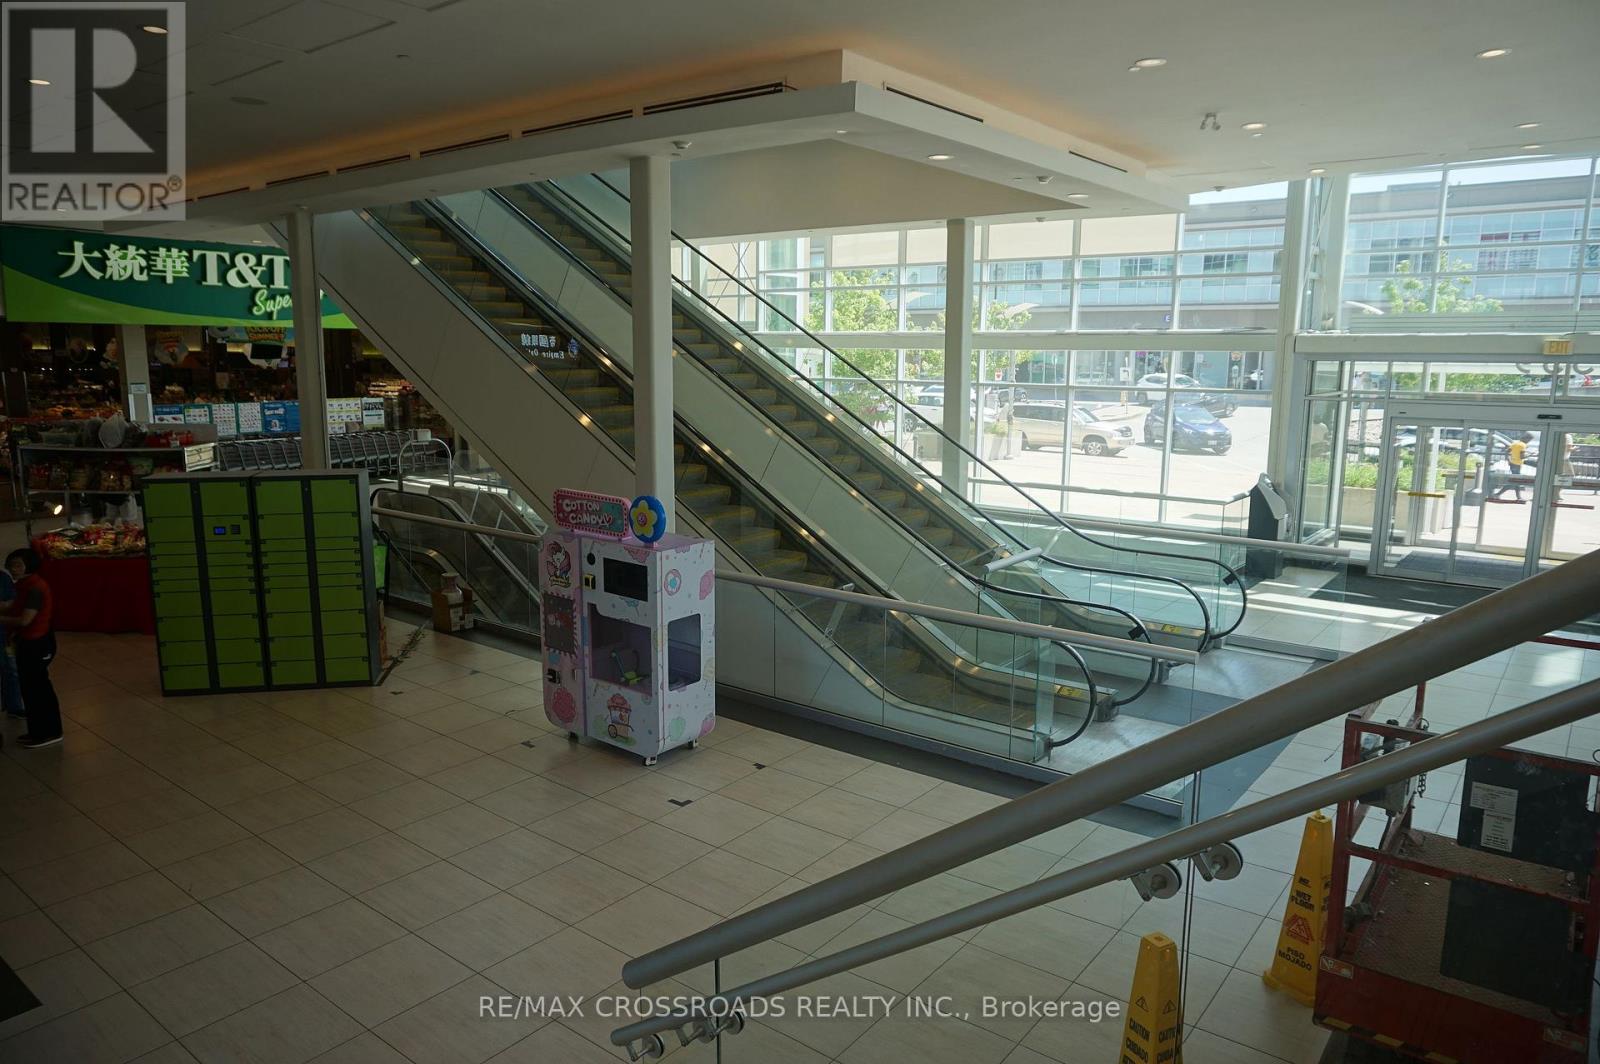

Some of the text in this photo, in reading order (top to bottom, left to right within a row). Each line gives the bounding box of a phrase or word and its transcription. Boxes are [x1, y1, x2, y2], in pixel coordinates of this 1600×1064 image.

[57, 240, 190, 285] 大統華
[192, 249, 290, 290] T&T
[563, 499, 600, 512] COTTON
[569, 512, 607, 526] CANDY
[1290, 896, 1315, 912] FLOOR
[1295, 889, 1312, 902] WET
[1278, 949, 1312, 971] MOJADO
[1286, 946, 1305, 960] PISO
[1129, 1017, 1151, 1041] CAUTION
[1125, 1037, 1149, 1063] CUIDADO
